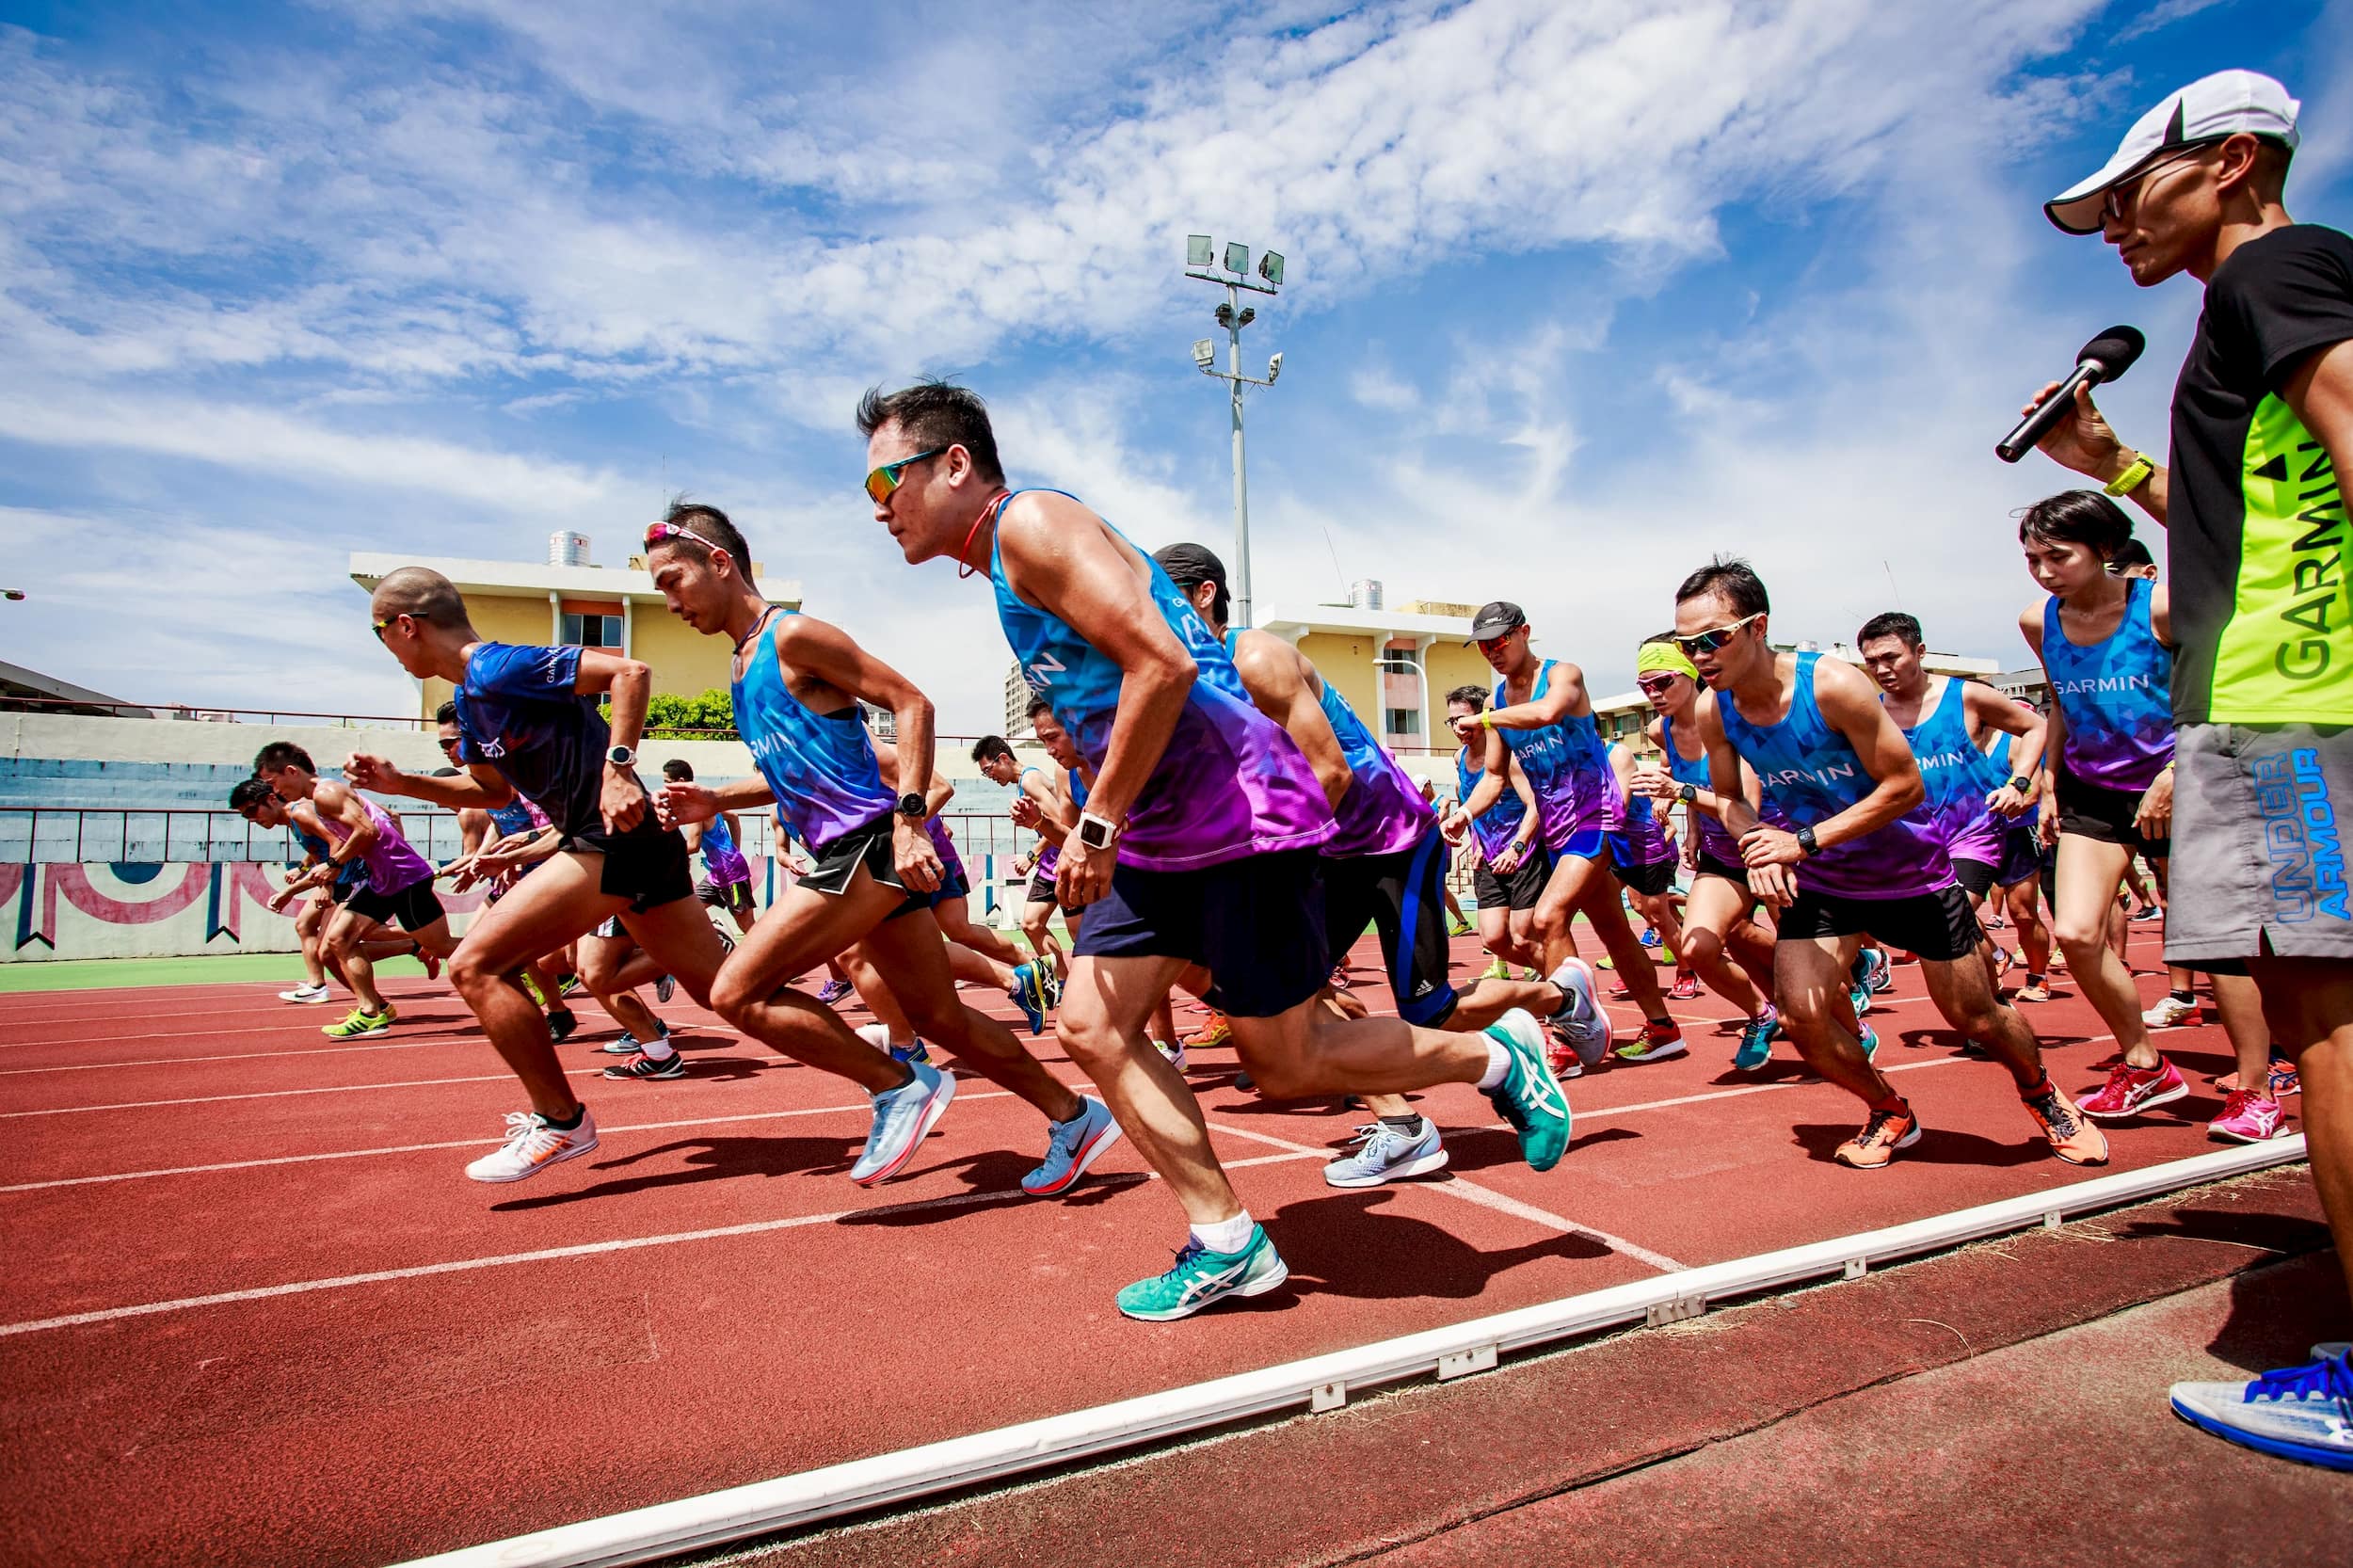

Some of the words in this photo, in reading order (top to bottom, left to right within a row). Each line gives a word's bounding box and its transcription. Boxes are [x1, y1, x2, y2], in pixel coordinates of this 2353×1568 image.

[2052, 674, 2149, 695] GARMIN
[2252, 752, 2315, 924] UNDER
[2292, 747, 2351, 920] ARMOUR
